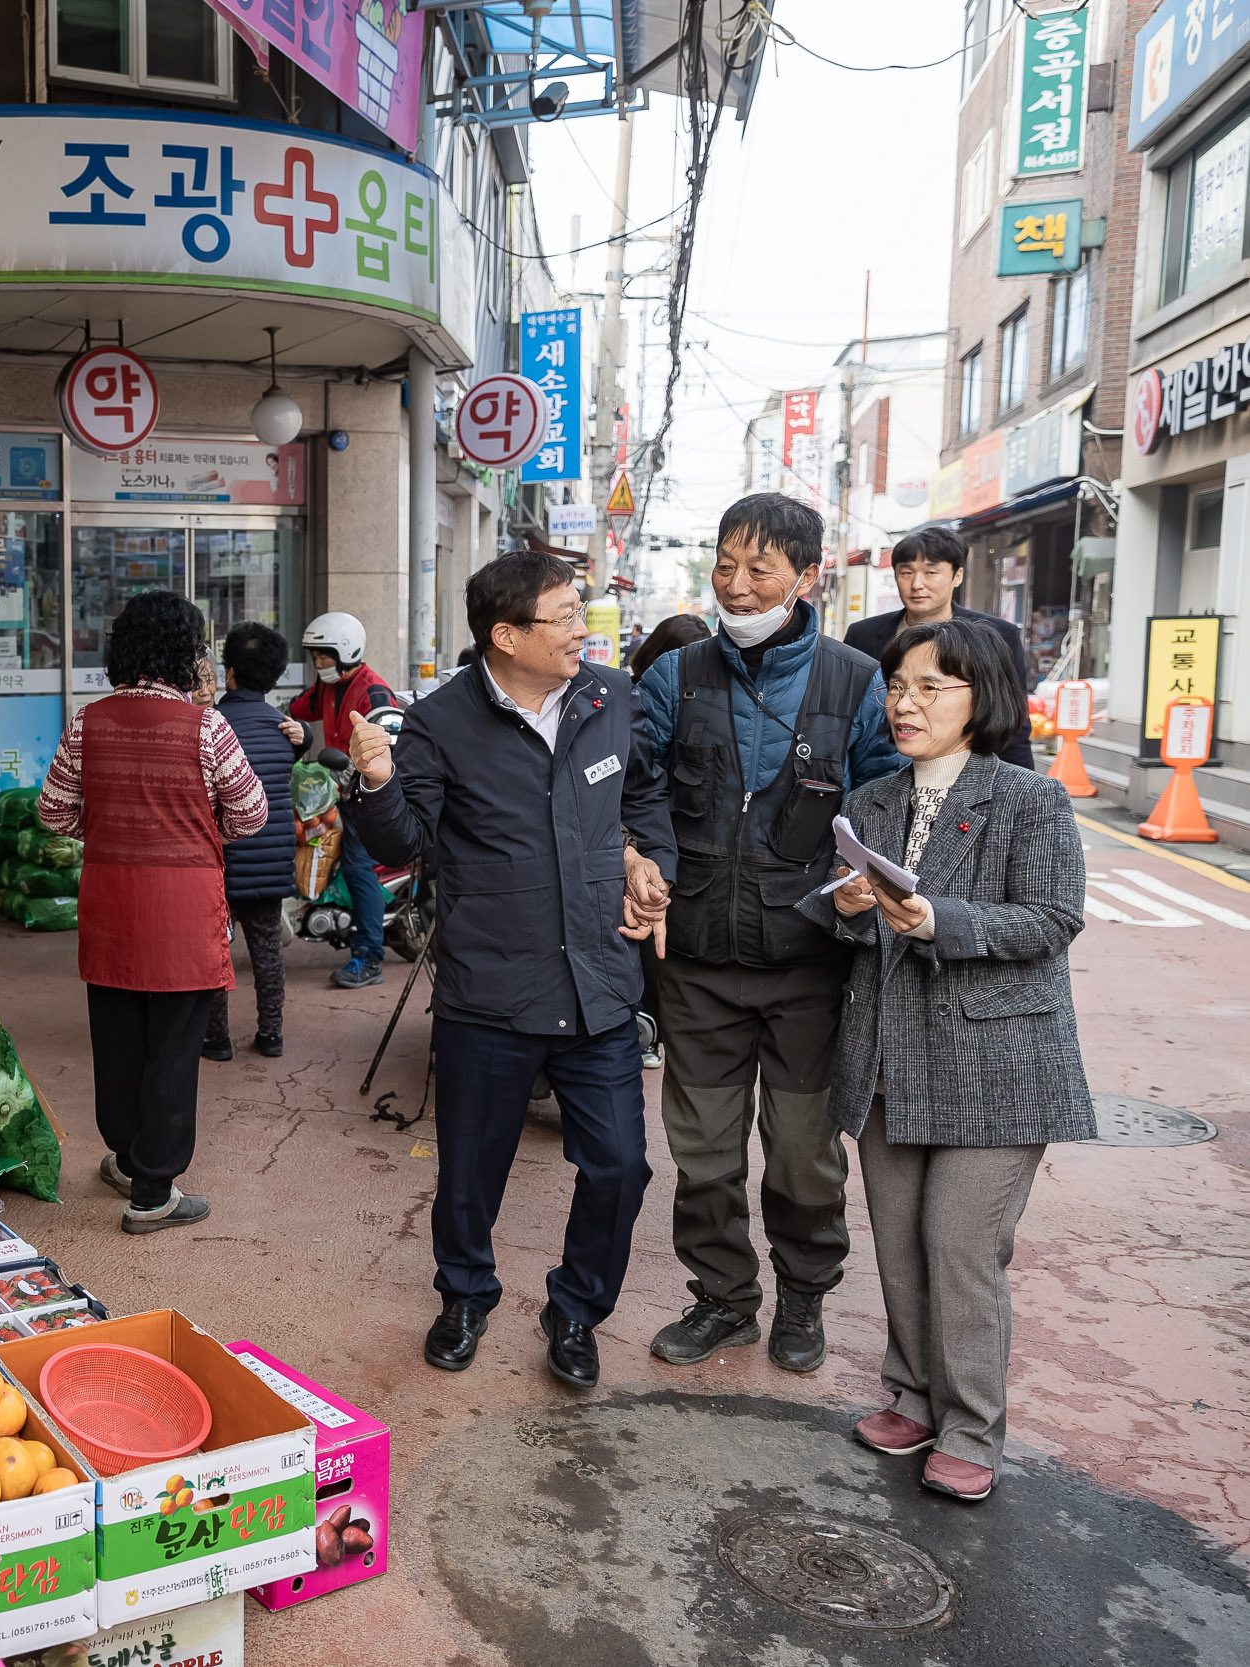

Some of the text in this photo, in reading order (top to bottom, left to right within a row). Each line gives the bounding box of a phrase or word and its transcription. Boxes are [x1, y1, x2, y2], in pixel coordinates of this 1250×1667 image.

[1025, 16, 1082, 151] 중곡서점
[49, 142, 246, 264] 조광
[1013, 213, 1067, 258] 책
[85, 364, 141, 433] 약
[470, 391, 521, 453] 약
[1170, 628, 1197, 705] 교통사
[202, 1464, 241, 1481] MUN SAN
[229, 1466, 270, 1482] PERSIMMON
[130, 1494, 286, 1560] 진주 문산 단감
[136, 1627, 146, 1636] 더
[150, 1619, 175, 1634] 건강한
